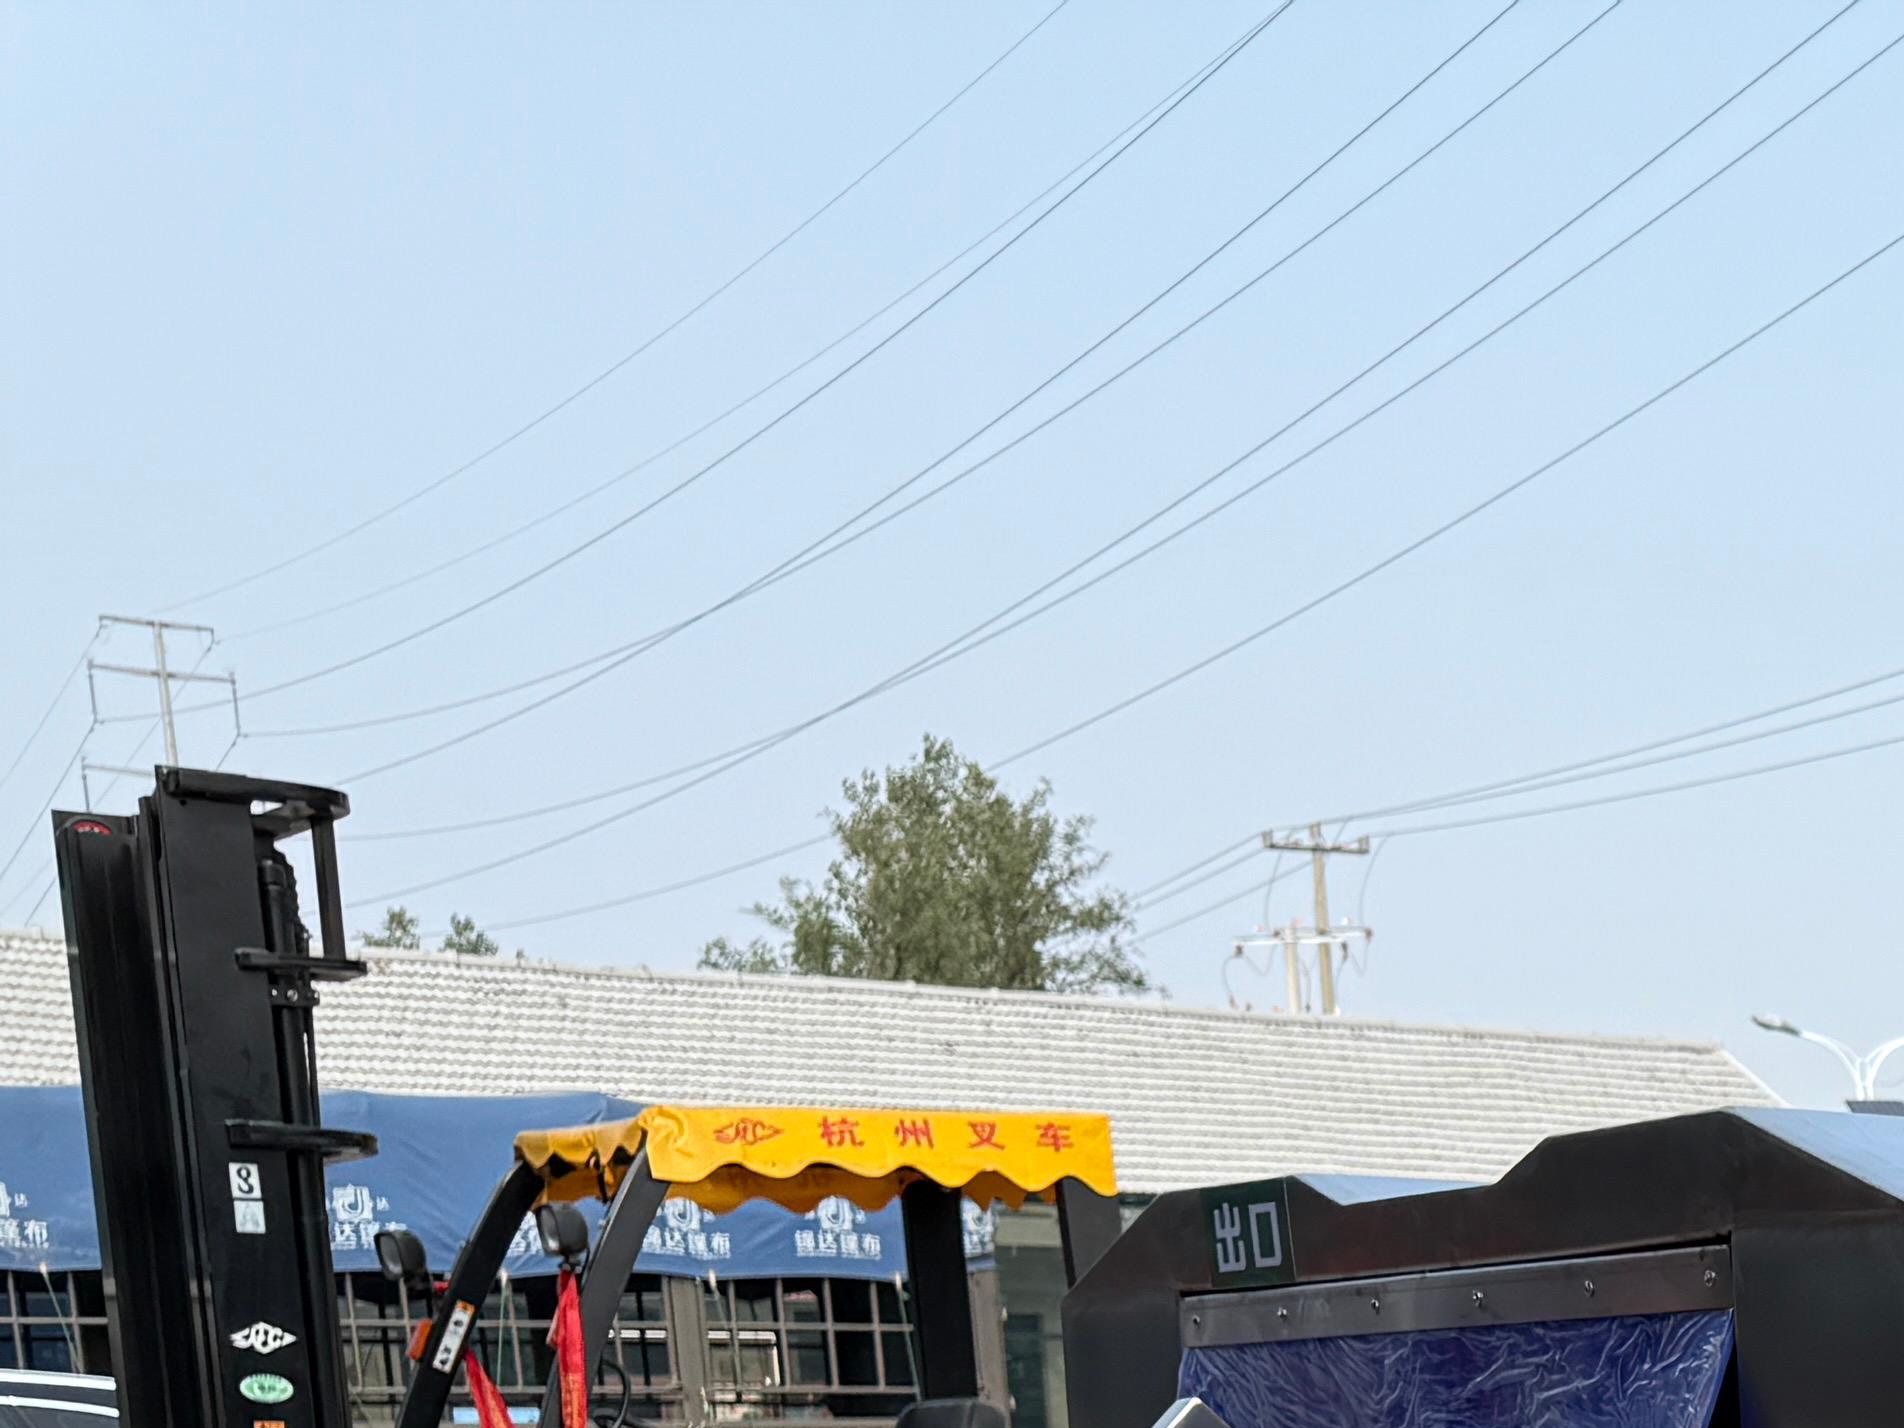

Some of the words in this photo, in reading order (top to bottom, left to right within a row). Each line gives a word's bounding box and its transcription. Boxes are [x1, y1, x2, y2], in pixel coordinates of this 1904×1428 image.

[819, 1117, 1073, 1151] 杭州叉车
[1213, 1201, 1282, 1273] 出口
